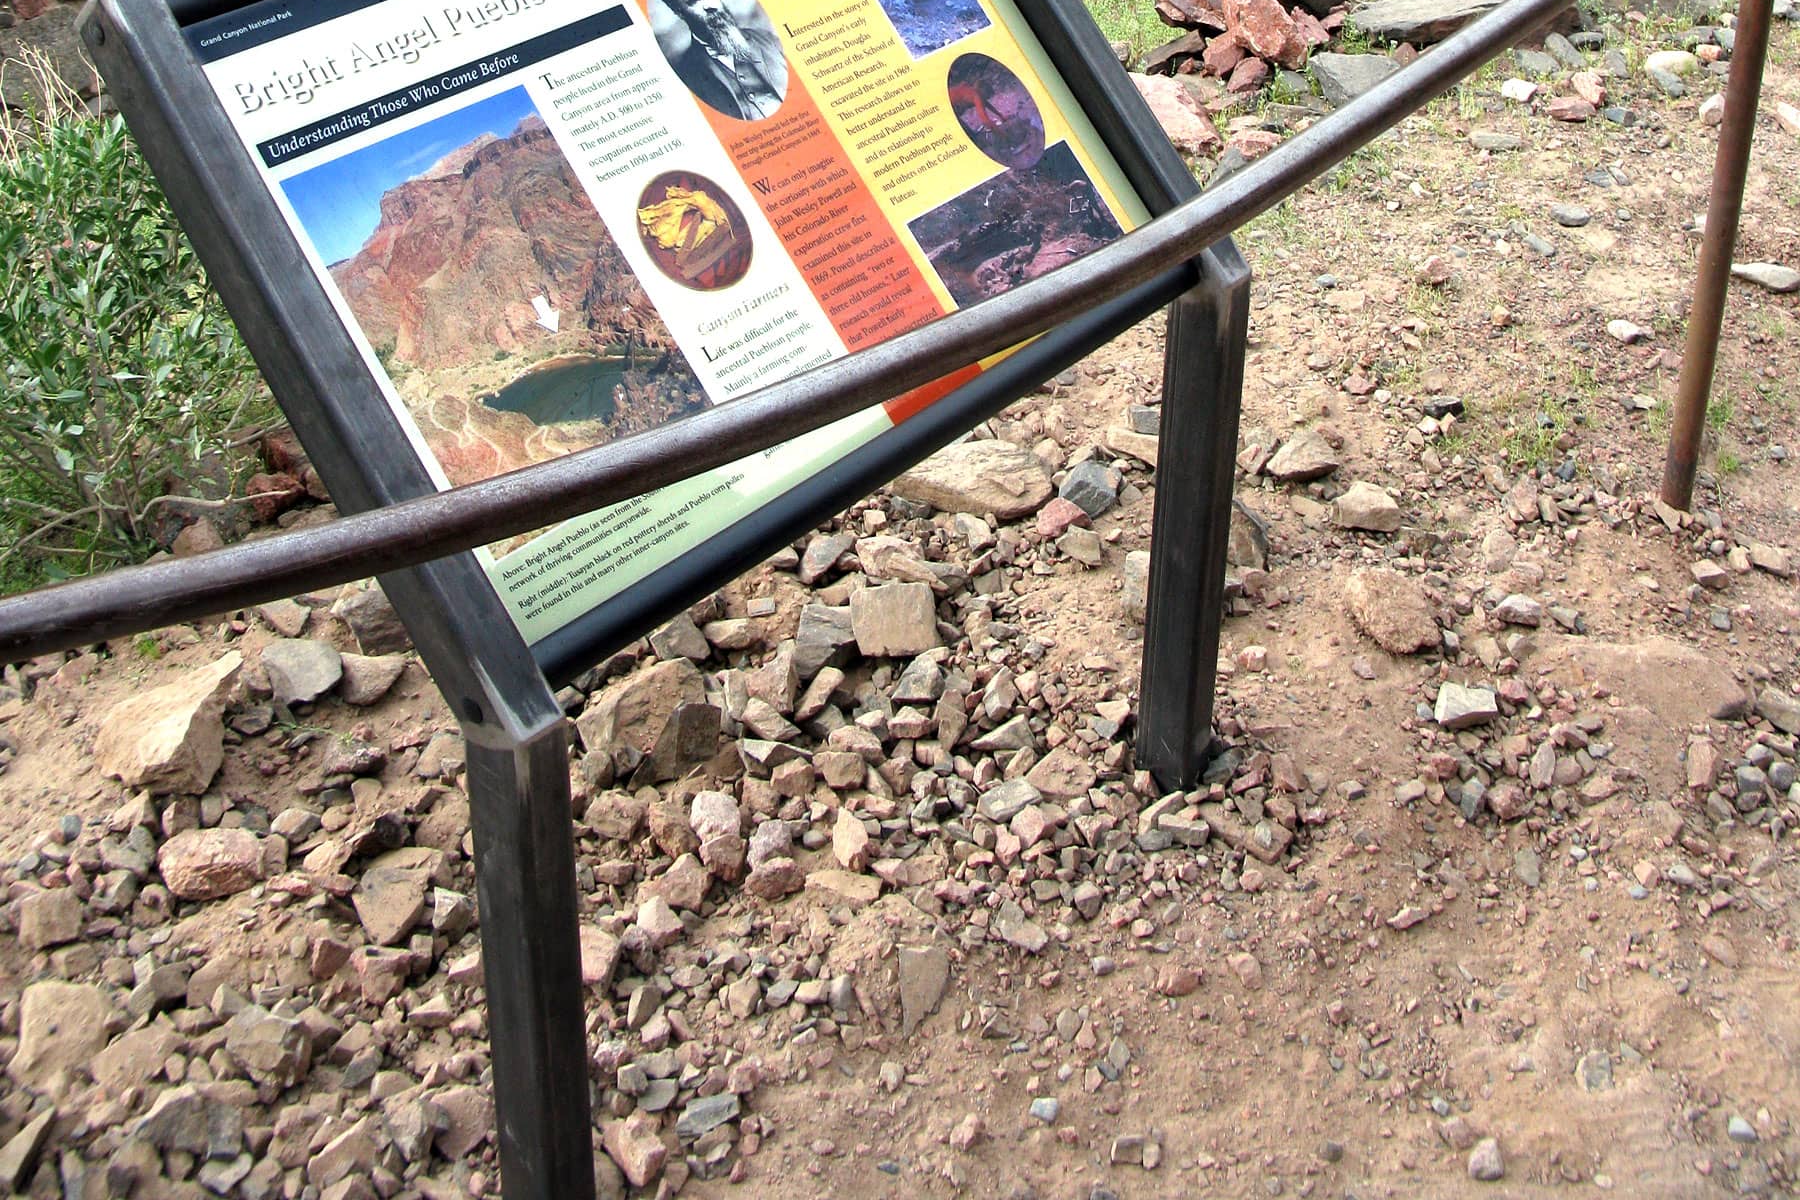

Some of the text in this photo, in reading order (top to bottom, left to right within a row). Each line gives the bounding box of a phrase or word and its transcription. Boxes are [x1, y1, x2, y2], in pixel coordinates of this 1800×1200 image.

[200, 10, 292, 46] Grand Canyon National Park
[783, 17, 824, 38] Interested
[831, 10, 844, 19] the
[844, 3, 861, 13] story
[795, 17, 866, 52] Grand early
[811, 36, 895, 79] Schwartz of the School of
[842, 33, 871, 48] Douglas
[235, 59, 343, 114] Bright
[352, 16, 440, 73] Angel
[538, 62, 601, 90] The ancestral
[821, 60, 886, 94] American Research,
[552, 63, 643, 109] people in the Grand
[561, 88, 631, 121] Canyon area from
[830, 74, 895, 107] excavated the site in
[837, 79, 920, 121] This research allows us to
[268, 54, 518, 157] Understanding Those Who Came Before
[570, 102, 643, 136] imately 500 to
[845, 99, 916, 135] better understand the
[577, 116, 653, 151] The most extensive
[856, 105, 939, 149] ancestral Puebloan culture
[864, 126, 933, 164] and relationship to
[588, 126, 668, 167] occupation occurred
[596, 146, 664, 182] between 1050 and
[873, 133, 952, 178] modern Puebloan people
[752, 156, 834, 195] We can only imagine
[882, 144, 968, 191] and others on the Colorado
[765, 167, 848, 212] the curiosity with which
[773, 180, 857, 229] John Wesley Powell and
[782, 204, 848, 241] his Colorado River
[793, 214, 867, 256] exploration first
[802, 231, 872, 271] examined this in
[830, 239, 889, 275] Powell described
[820, 272, 868, 301] as containing
[848, 266, 910, 304] old Later
[838, 294, 892, 330] research would
[860, 317, 888, 336] Powell
[701, 309, 798, 362] Life was difficult for the
[715, 322, 811, 378] ancestral Puebloan people.
[723, 375, 752, 393] Mainly
[757, 355, 789, 375] farming
[502, 493, 641, 581] Above: Bright Angel Pueblo (as seen from the
[508, 507, 651, 592] network of thriving communities canyonwide.
[517, 473, 744, 609] Right (middle): Tusayan black on red pottery sherds and Pueblo corn pollen
[525, 520, 689, 619] were found in this and many other inner-canyon sites.
